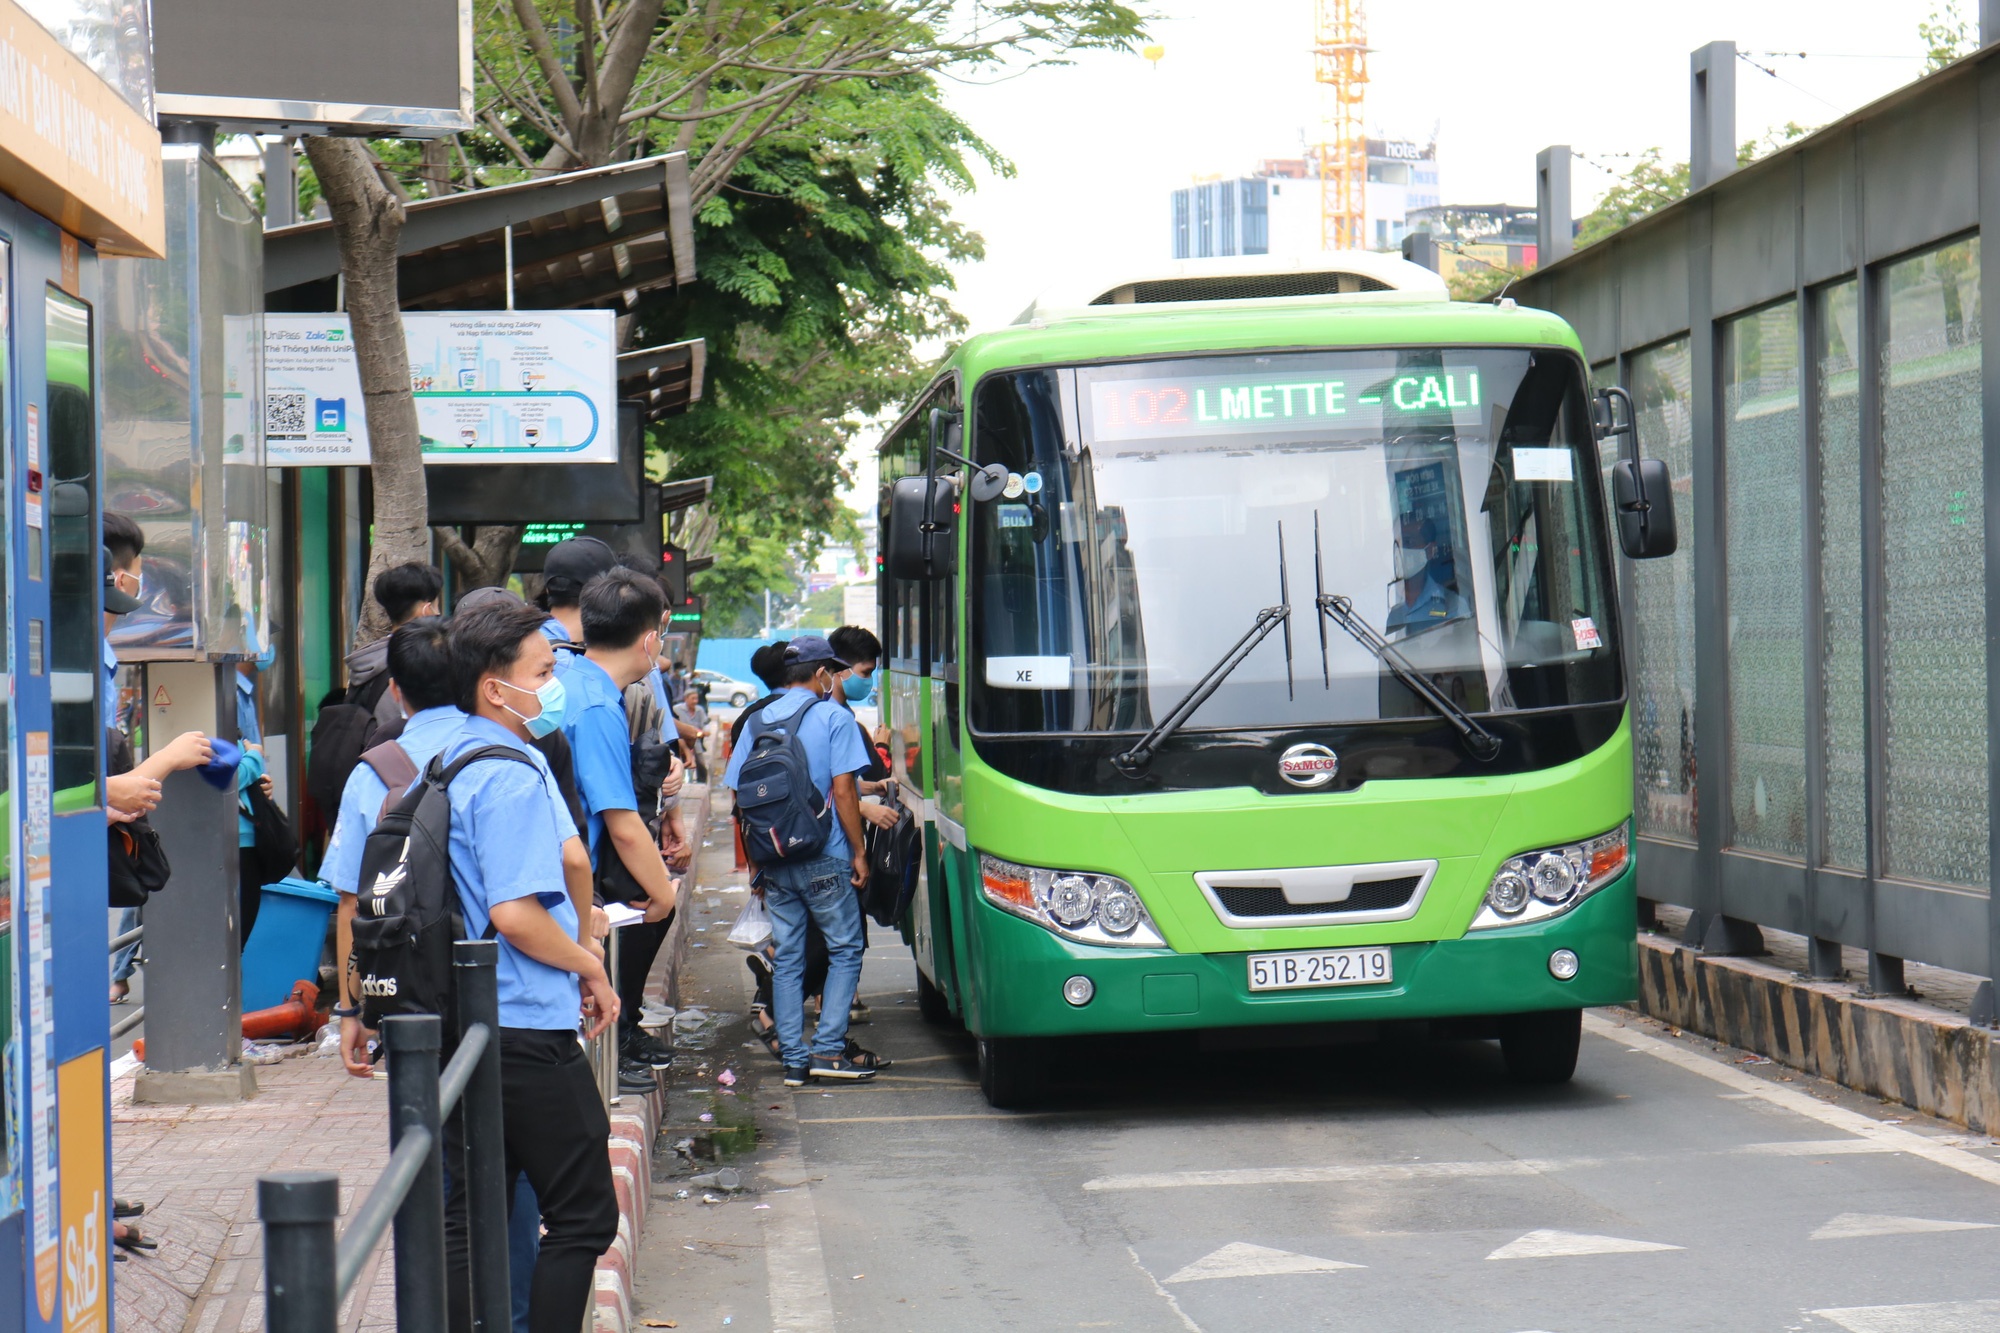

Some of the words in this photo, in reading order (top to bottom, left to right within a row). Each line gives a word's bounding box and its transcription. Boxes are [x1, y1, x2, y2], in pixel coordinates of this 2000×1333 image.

[31, 54, 62, 150] BÁN
[62, 78, 99, 180] HÀNG
[100, 115, 116, 204] TỰ
[265, 331, 300, 340] UniPass
[283, 345, 309, 354] Thông
[1104, 387, 1188, 426] 102
[1002, 516, 1027, 527] BUS
[1016, 670, 1032, 682] XE
[1284, 759, 1334, 772] SAMCO
[811, 876, 839, 893] DKNY
[1253, 952, 1386, 986] 51B-252.19
[66, 1190, 99, 1323] S&B
